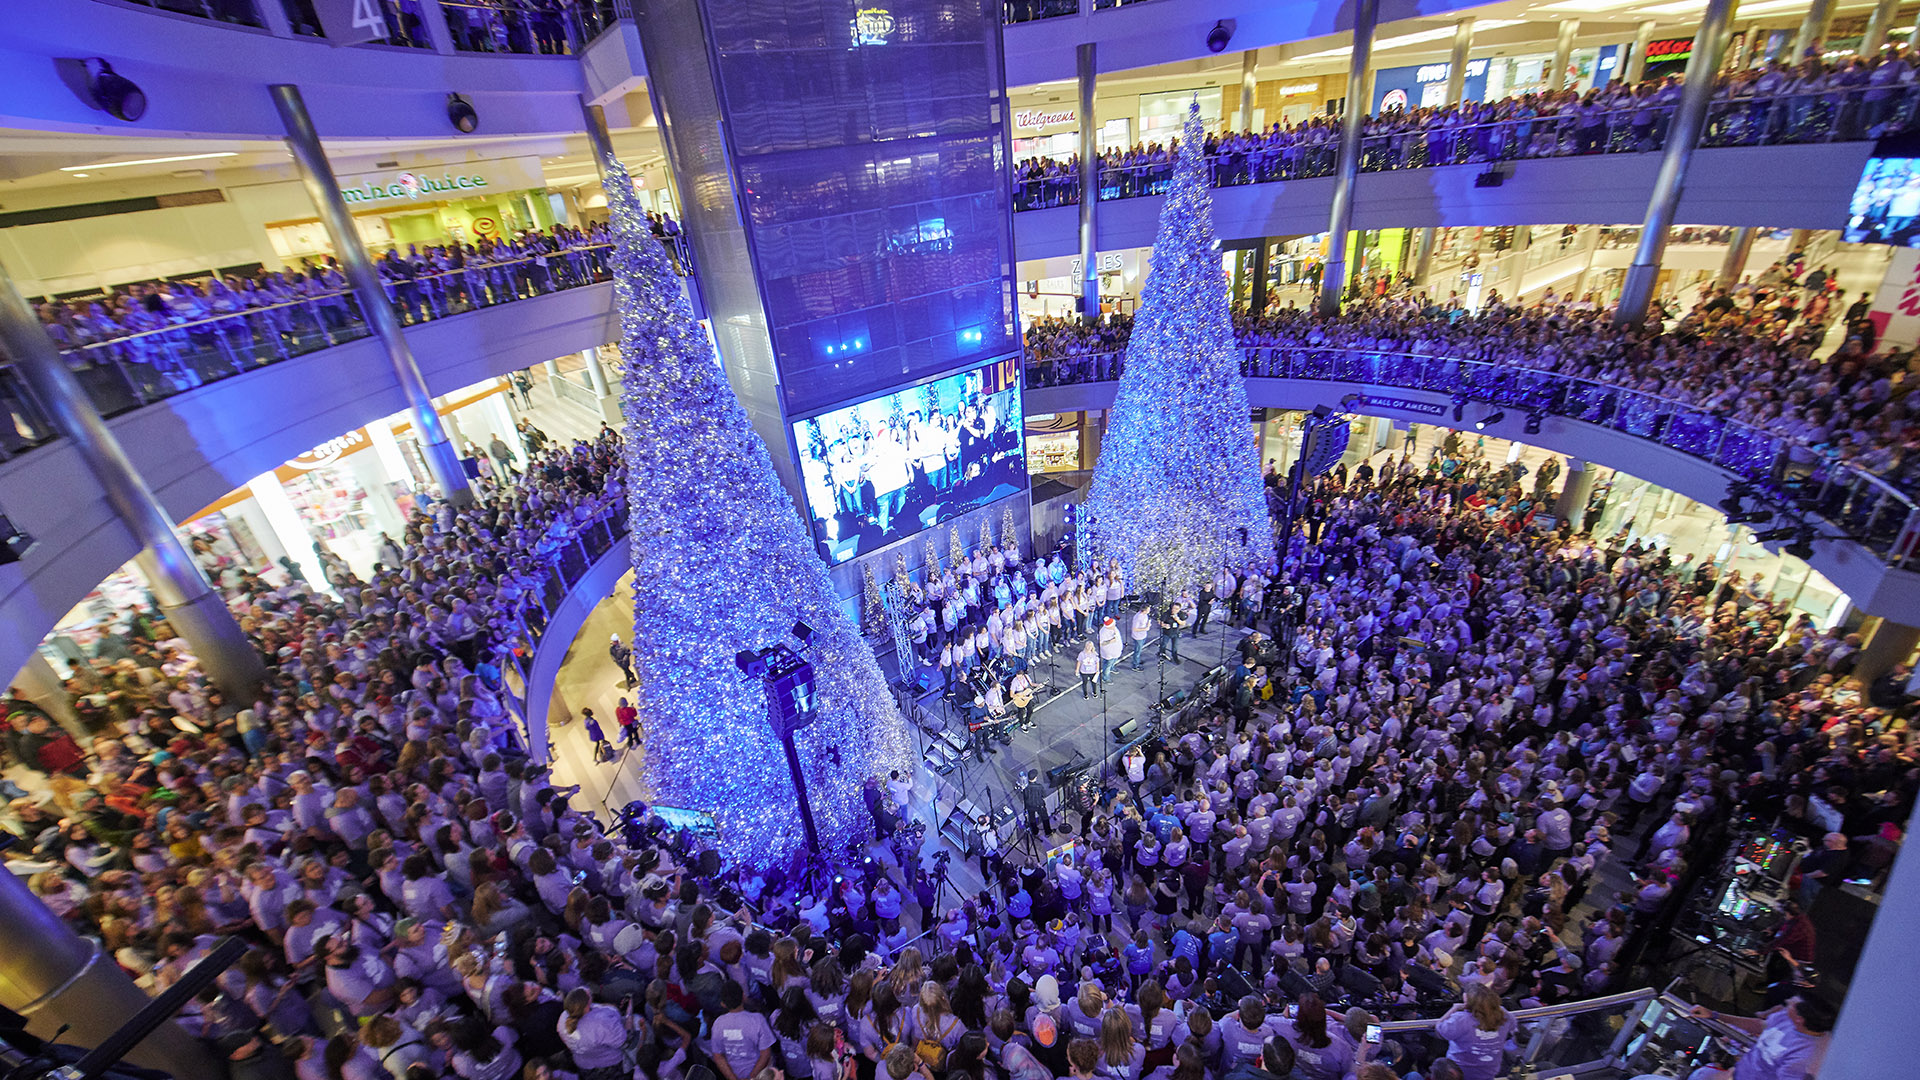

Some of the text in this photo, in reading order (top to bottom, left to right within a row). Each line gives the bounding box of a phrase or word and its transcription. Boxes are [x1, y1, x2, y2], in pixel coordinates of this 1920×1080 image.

[352, 0, 383, 37] 4
[1016, 111, 1076, 130] Walgreens
[341, 173, 488, 203] mba Juice
[1072, 255, 1123, 275] ZLES
[1370, 398, 1441, 413] MALL OF AMERICA
